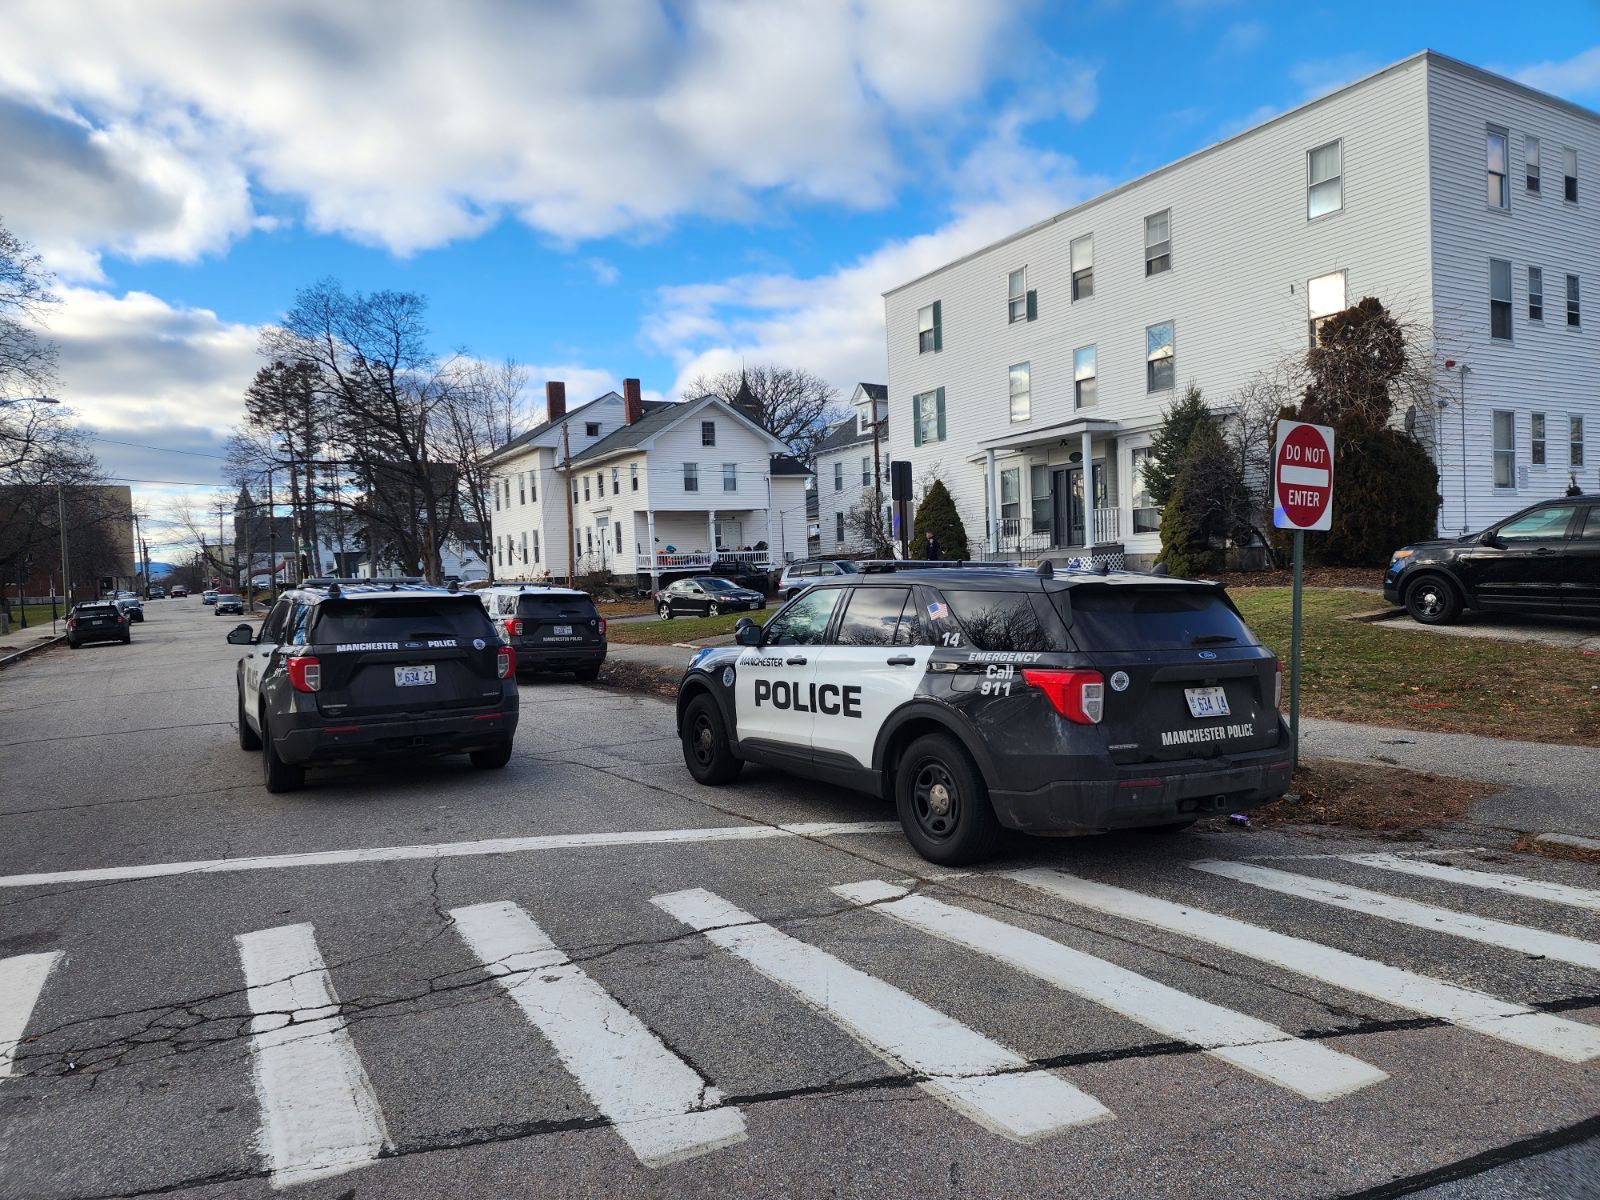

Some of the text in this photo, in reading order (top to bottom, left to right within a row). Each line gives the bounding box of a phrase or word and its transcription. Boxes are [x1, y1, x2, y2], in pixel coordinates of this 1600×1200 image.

[1286, 444, 1325, 463] DO NOT
[1288, 489, 1320, 507] ENTER
[336, 642, 399, 653] MANCHESTER
[428, 639, 458, 648] POLICE
[942, 632, 960, 647] 14
[739, 656, 783, 668] MANCHESTER
[968, 652, 1042, 663] EMERGENCY
[405, 672, 419, 682] 634
[423, 671, 433, 681] 27
[986, 663, 1014, 680] Call
[980, 681, 1012, 697] 911
[755, 679, 862, 719] POLICE
[1197, 697, 1213, 711] 634
[1215, 696, 1227, 710] 14
[1161, 723, 1254, 746] MANCHESTER POLICE
